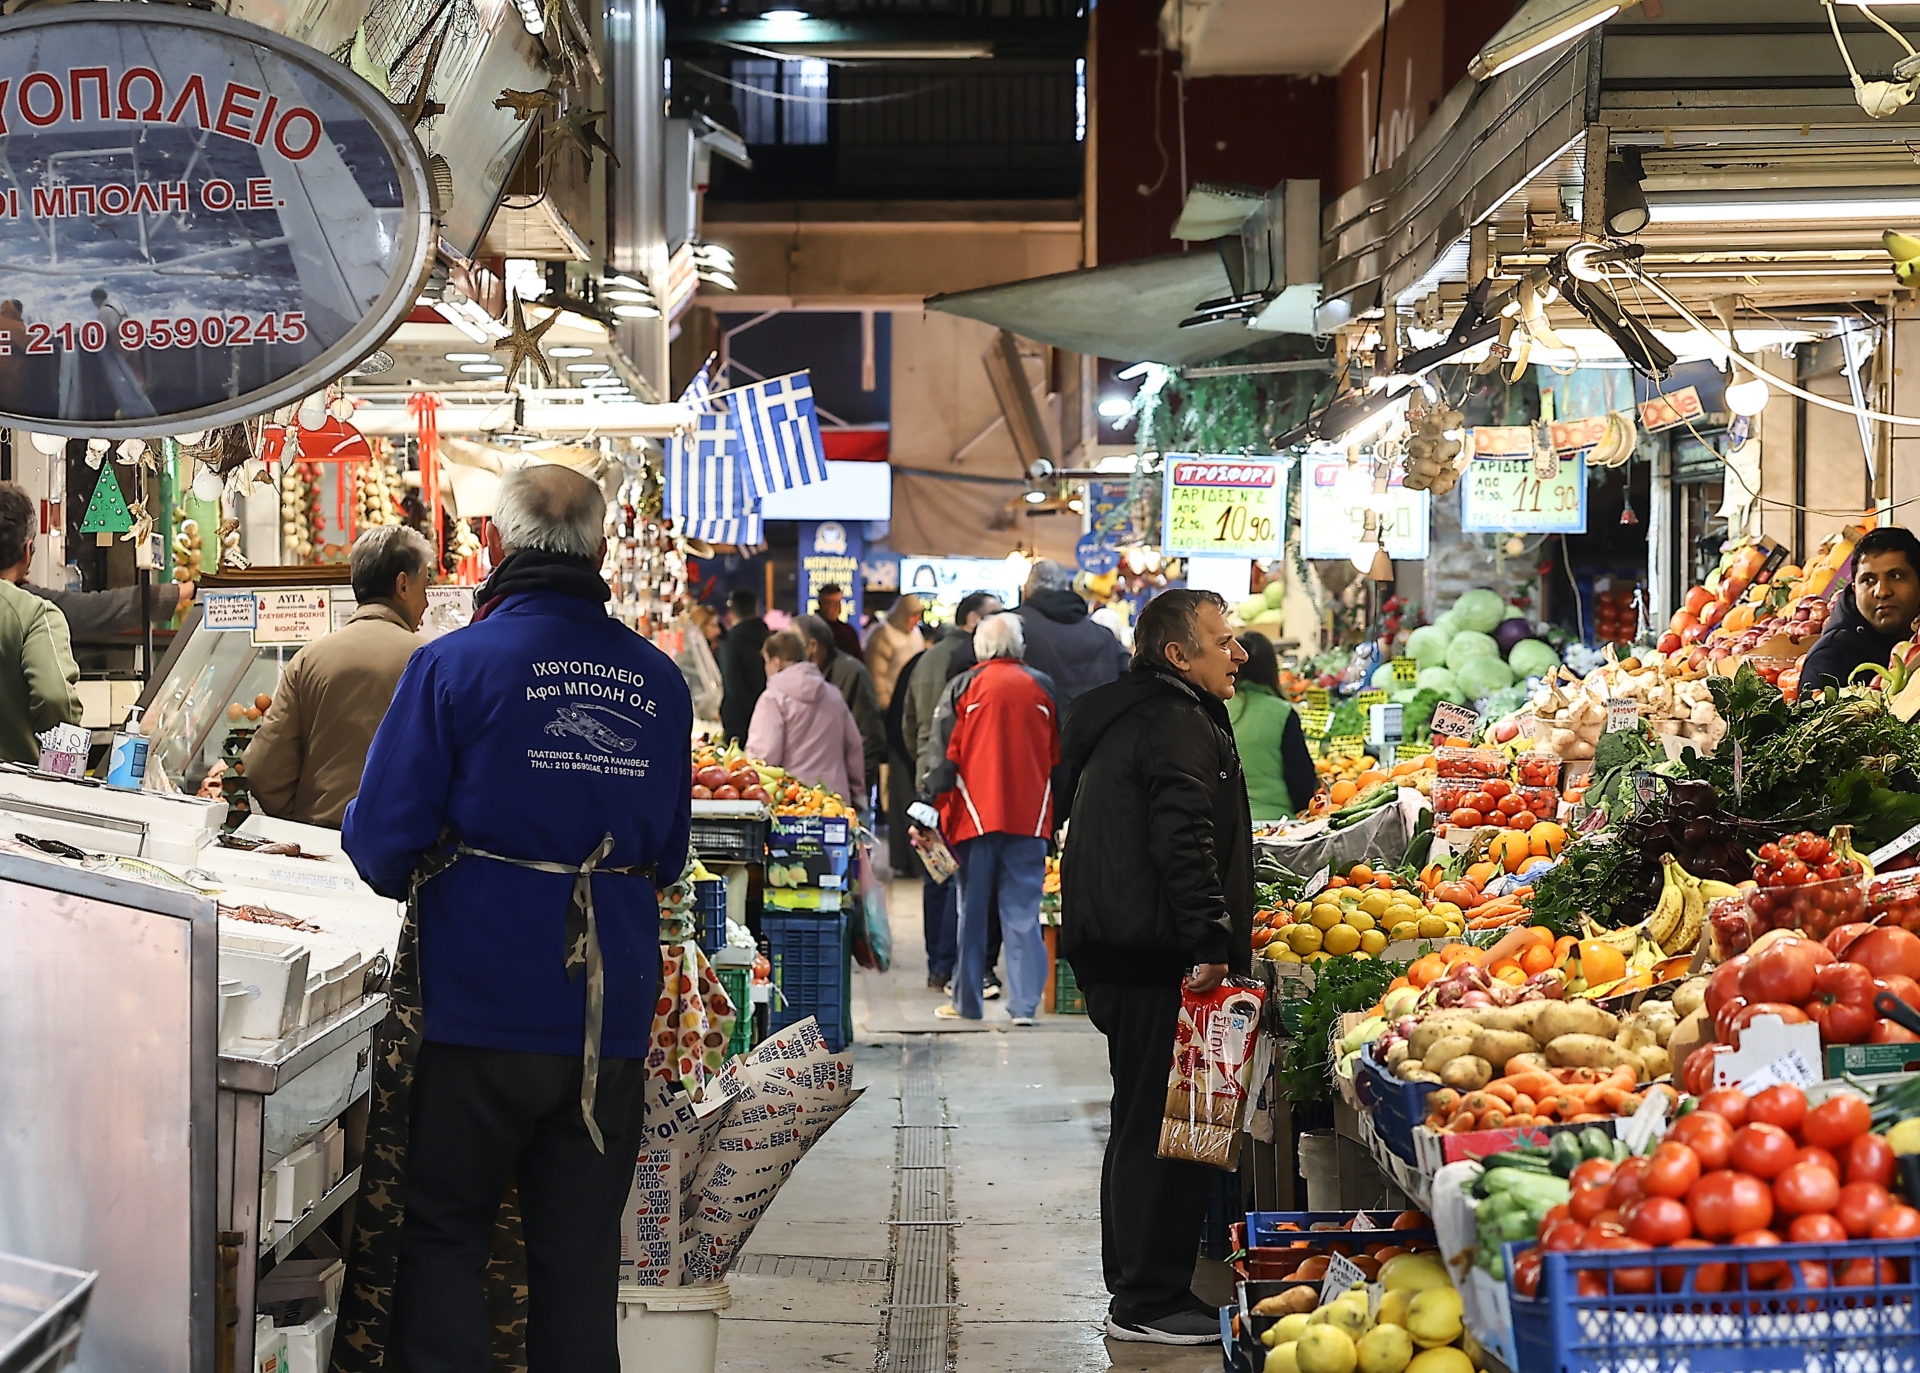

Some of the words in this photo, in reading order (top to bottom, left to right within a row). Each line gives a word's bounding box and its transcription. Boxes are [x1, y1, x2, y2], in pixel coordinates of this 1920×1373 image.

[32, 179, 189, 219] ΜΠΟΛΗ
[200, 177, 286, 212] Ο.Ε.
[25, 319, 106, 355] 210
[119, 311, 308, 351] 9590245
[1643, 392, 1699, 426] Dole
[1550, 416, 1609, 448] Dole
[1474, 427, 1532, 453] Dole
[1469, 460, 1529, 474] ΓΑΡΙΔΕΣ
[1178, 465, 1274, 485] ΠΡΟΣΦΟΡΑ
[1172, 487, 1235, 503] ΓΑΡΙΔΕΣ
[277, 593, 305, 604] ΑΥΓΑ
[258, 612, 297, 620] ΕΛΕΥΘΕΡΗΣ
[298, 611, 326, 619] ΒΟΣΚΗΣ
[274, 625, 311, 633] ΒΙΟΛΟΓΙΚΑ
[532, 661, 645, 688] ΙΧΘΥΟΠΩΛΕΙΟ
[526, 685, 561, 701] Αφοι
[564, 681, 625, 703] ΜΠΟΛΗ
[629, 693, 657, 718] Ο.Ε.
[527, 749, 574, 761] ΠΛΑΤΩΝΟΣ
[584, 753, 609, 764] ΑΓΟΡΑ
[610, 757, 650, 768] ΚΑΛΛΙΘΕΑΣ
[555, 761, 570, 770] 210
[604, 766, 618, 774] 210
[619, 768, 645, 778] 9578135
[799, 1029, 812, 1046] ΛΕΙΟ
[639, 1164, 661, 1173] ΙΧΘΥ
[639, 1173, 659, 1181] ΟΠΩ
[639, 1181, 660, 1190] ΛΕΙΟ
[648, 1190, 669, 1199] ΛΕΙΟ
[650, 1198, 669, 1206] ΟΠΩ
[648, 1205, 669, 1214] ΙΧΘΥ
[639, 1216, 661, 1225] ΙΧΘΥ
[639, 1225, 659, 1233] ΟΠΩ
[639, 1233, 660, 1242] ΛΕΙΟ
[648, 1242, 669, 1251] ΛΕΙΟ
[650, 1250, 669, 1258] ΟΠΩ
[648, 1257, 669, 1266] ΙΧΘΥ
[639, 1269, 661, 1278] ΙΧΘΥ
[639, 1277, 659, 1287] ΟΠΩ
